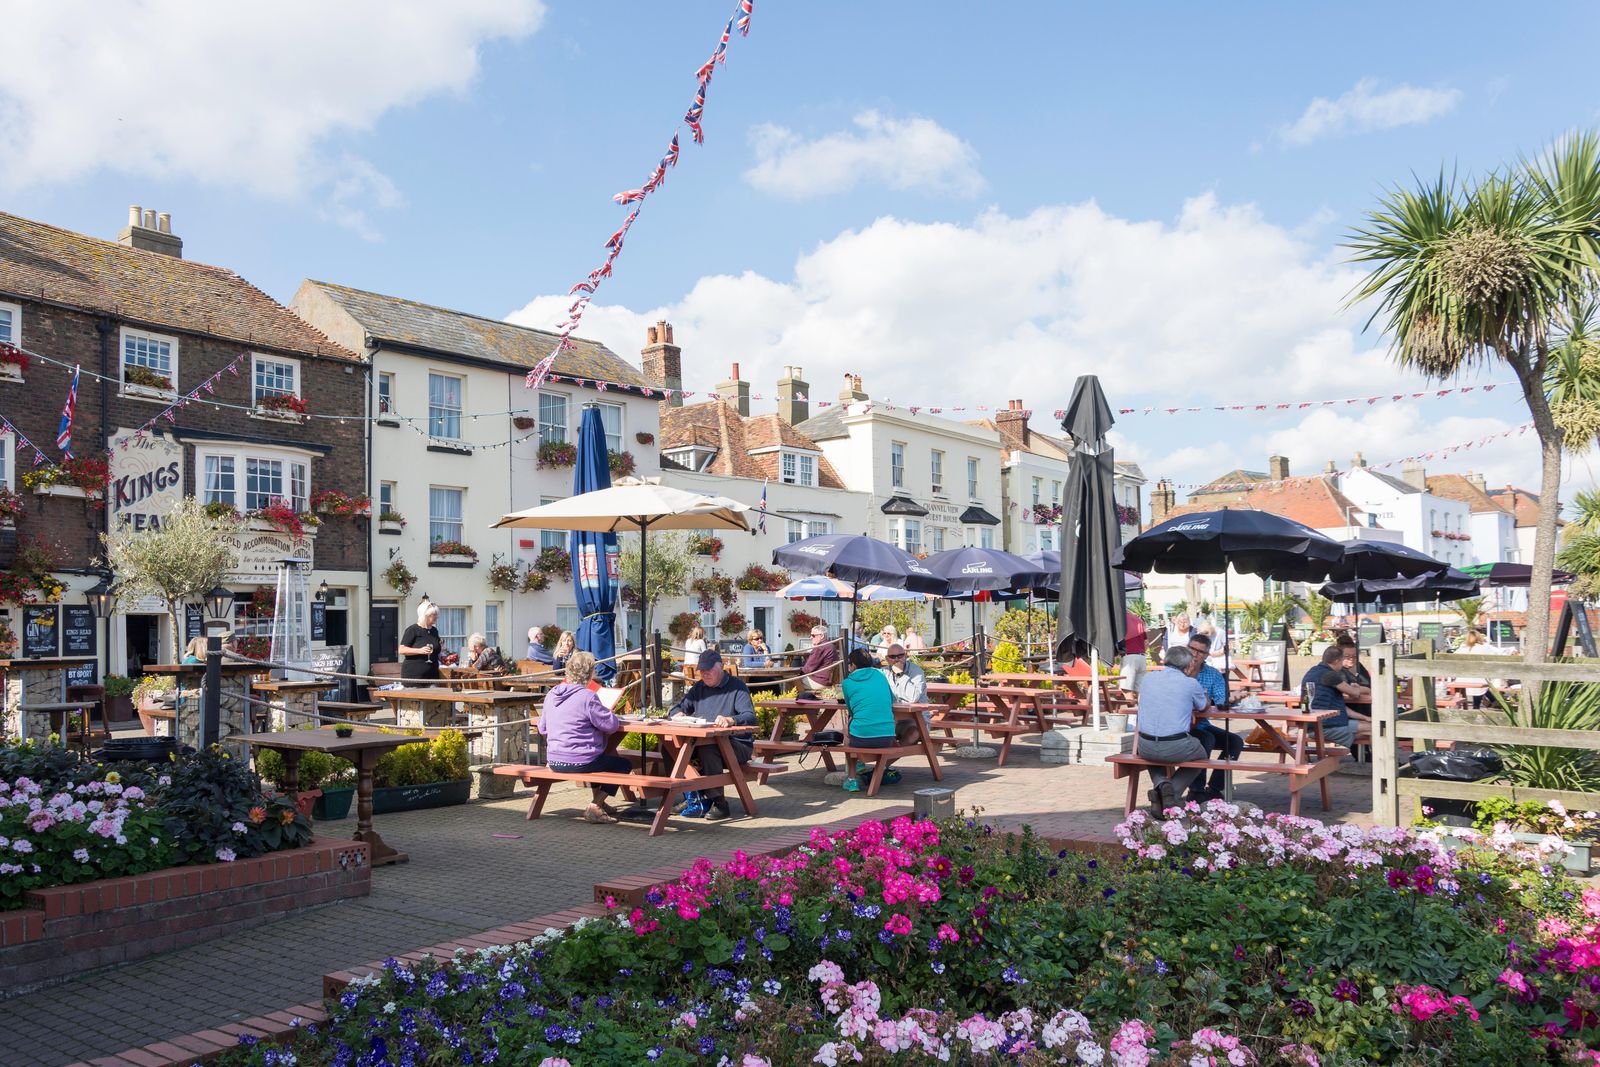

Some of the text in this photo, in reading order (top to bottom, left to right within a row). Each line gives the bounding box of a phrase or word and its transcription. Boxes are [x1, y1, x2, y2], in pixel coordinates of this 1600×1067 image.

[113, 461, 180, 514] KINGS
[117, 512, 168, 533] HEA
[221, 535, 241, 549] COLD
[243, 536, 291, 552] ACCOMMODATION
[962, 565, 993, 574] CARLING
[326, 659, 343, 667] HEAD
[76, 670, 92, 679] SPORT
